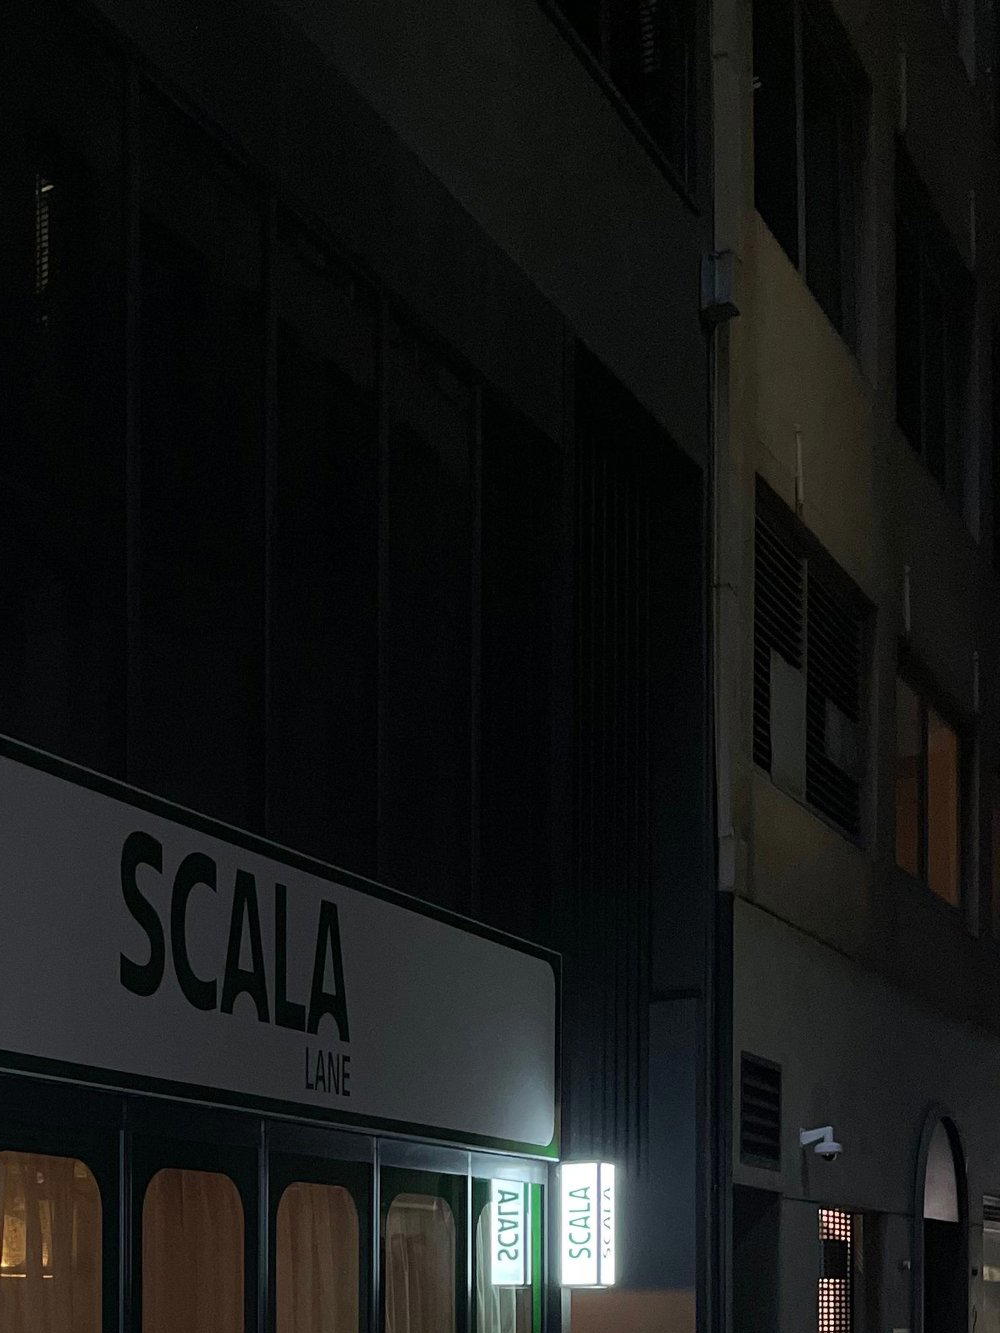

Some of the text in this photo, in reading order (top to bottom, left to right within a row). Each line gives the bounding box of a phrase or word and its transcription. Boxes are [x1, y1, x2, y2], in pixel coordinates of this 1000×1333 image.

[120, 830, 350, 1044] SCALA
[305, 1046, 350, 1097] LANE
[568, 1186, 592, 1259] SCALA
